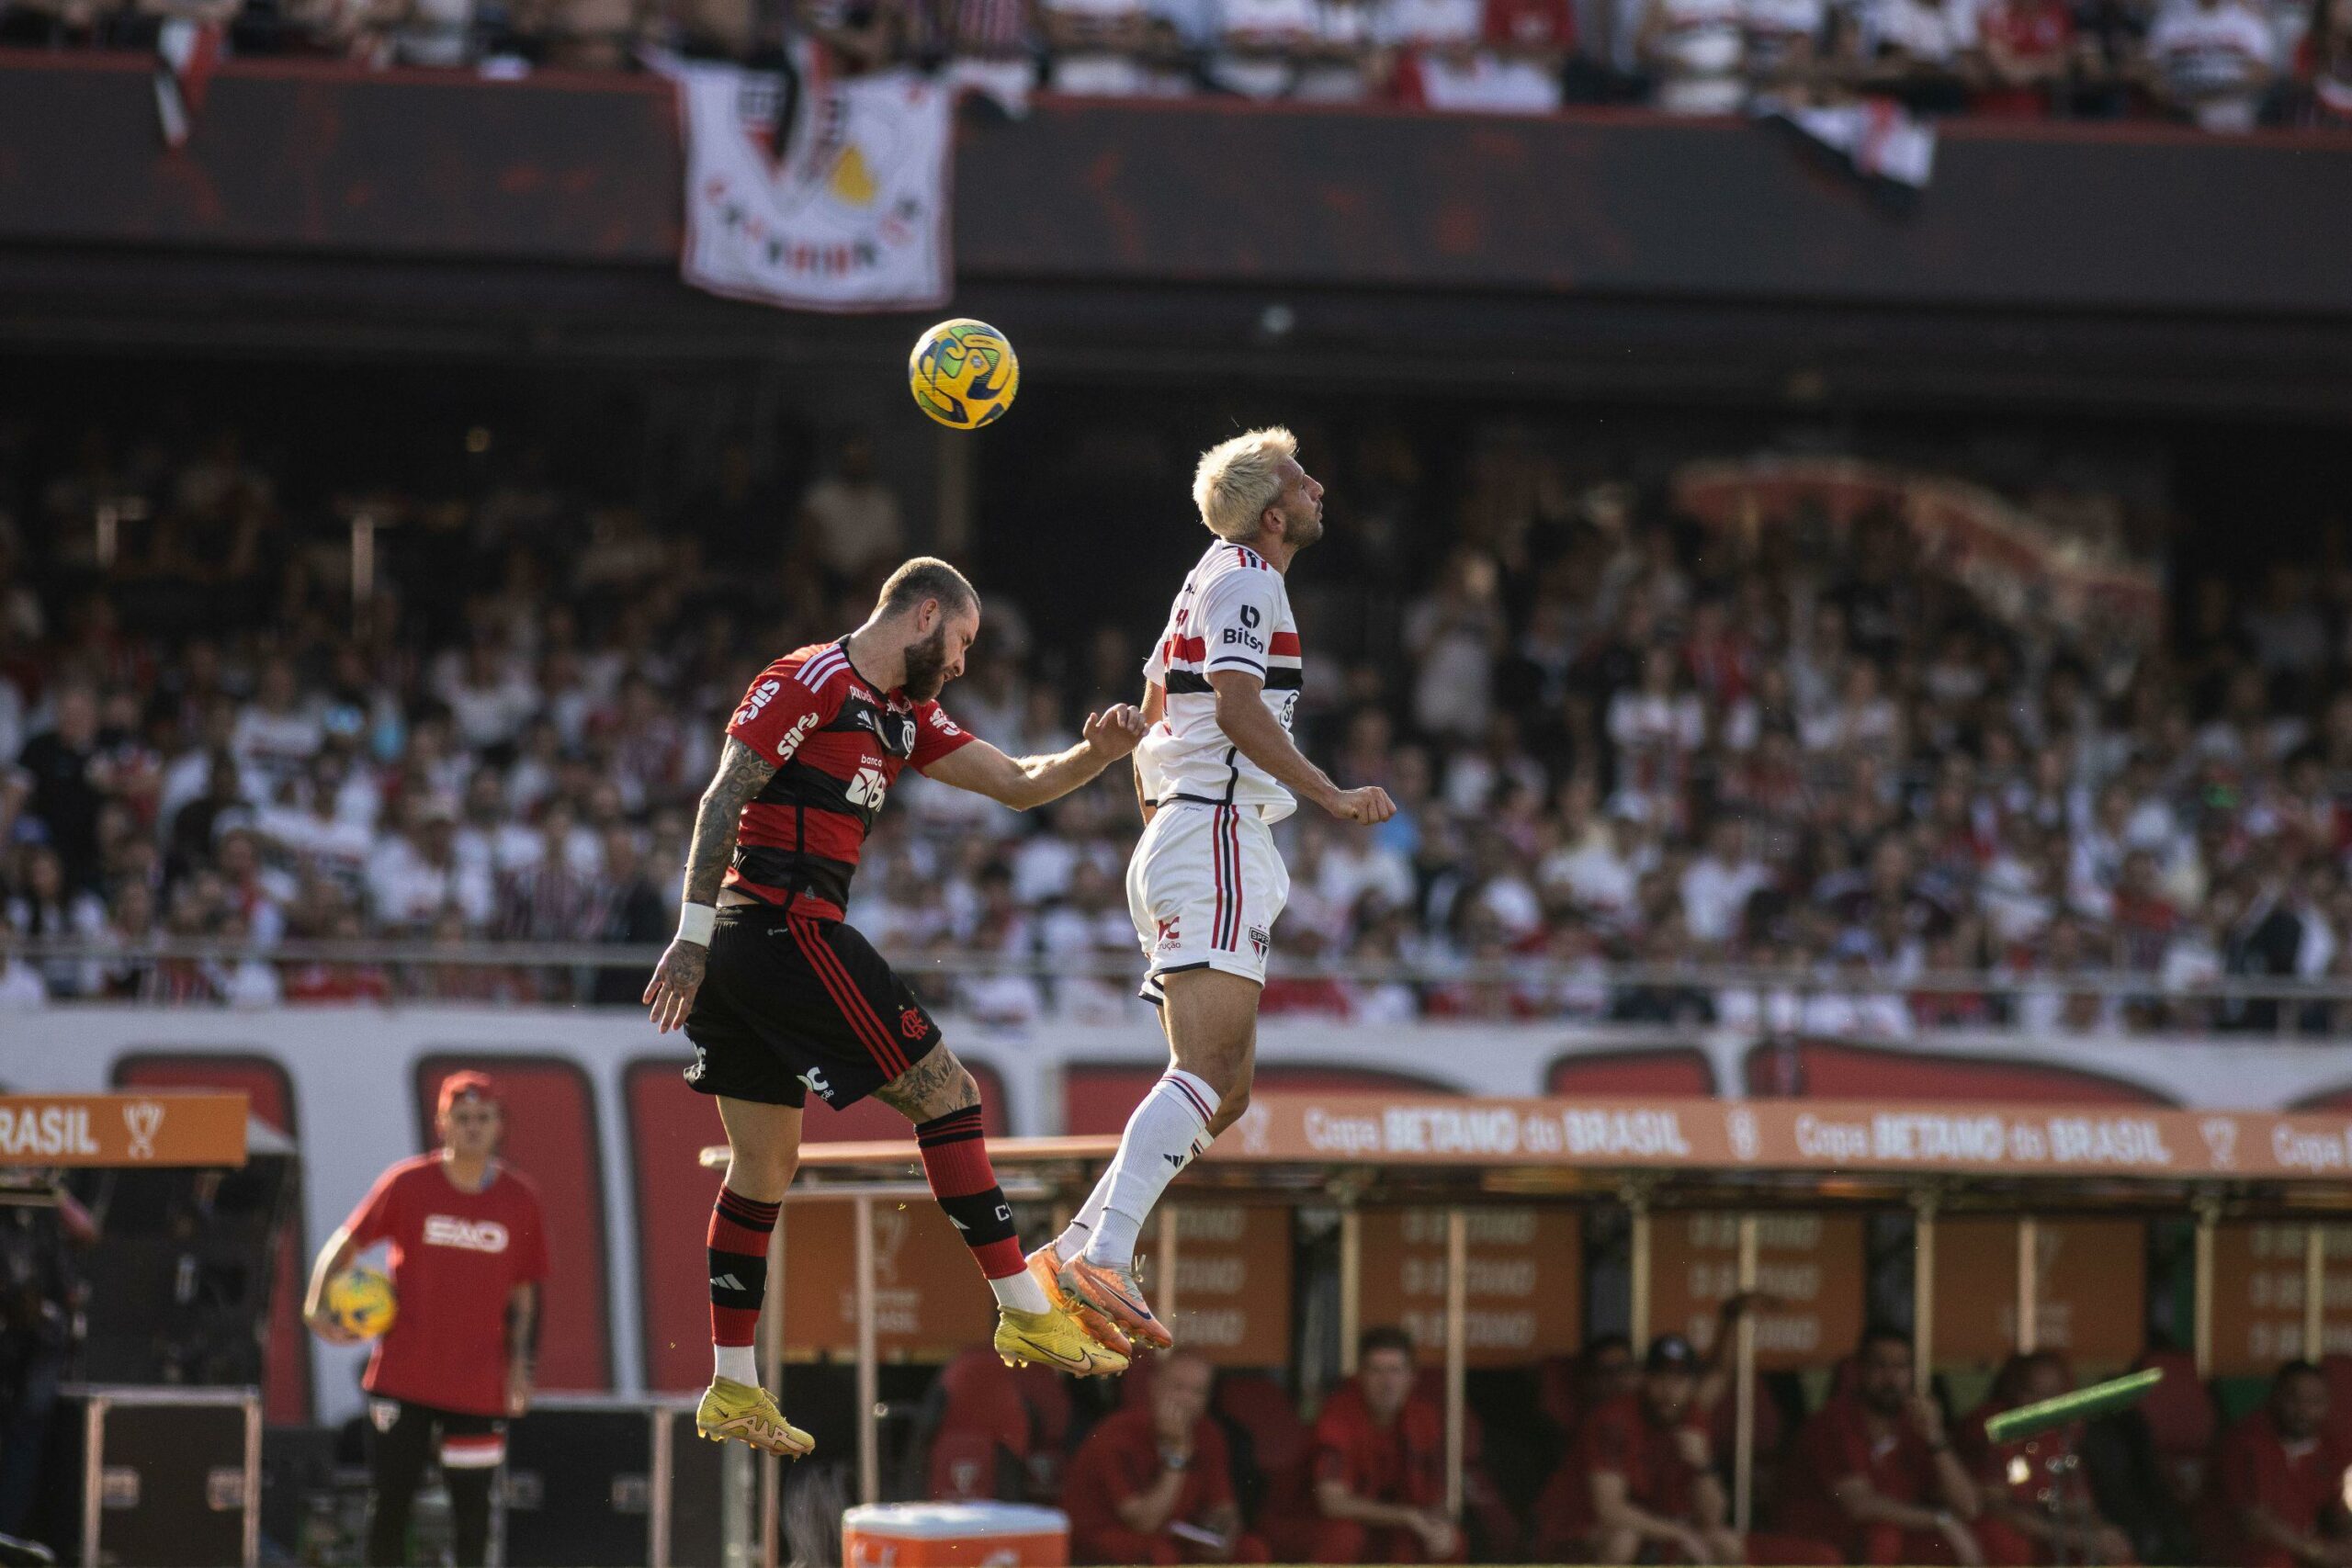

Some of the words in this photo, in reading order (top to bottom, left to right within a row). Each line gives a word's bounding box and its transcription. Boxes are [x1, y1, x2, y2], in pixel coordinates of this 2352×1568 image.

[861, 753, 883, 768] banco
[1304, 1106, 1378, 1158] Copa
[1383, 1106, 1518, 1155] BETANO
[1562, 1108, 1690, 1157] BRASIL
[1794, 1112, 1868, 1166] Copa
[1871, 1111, 2002, 1160] BETANO
[2047, 1115, 2174, 1166] BRASIL
[994, 1202, 1013, 1222] C
